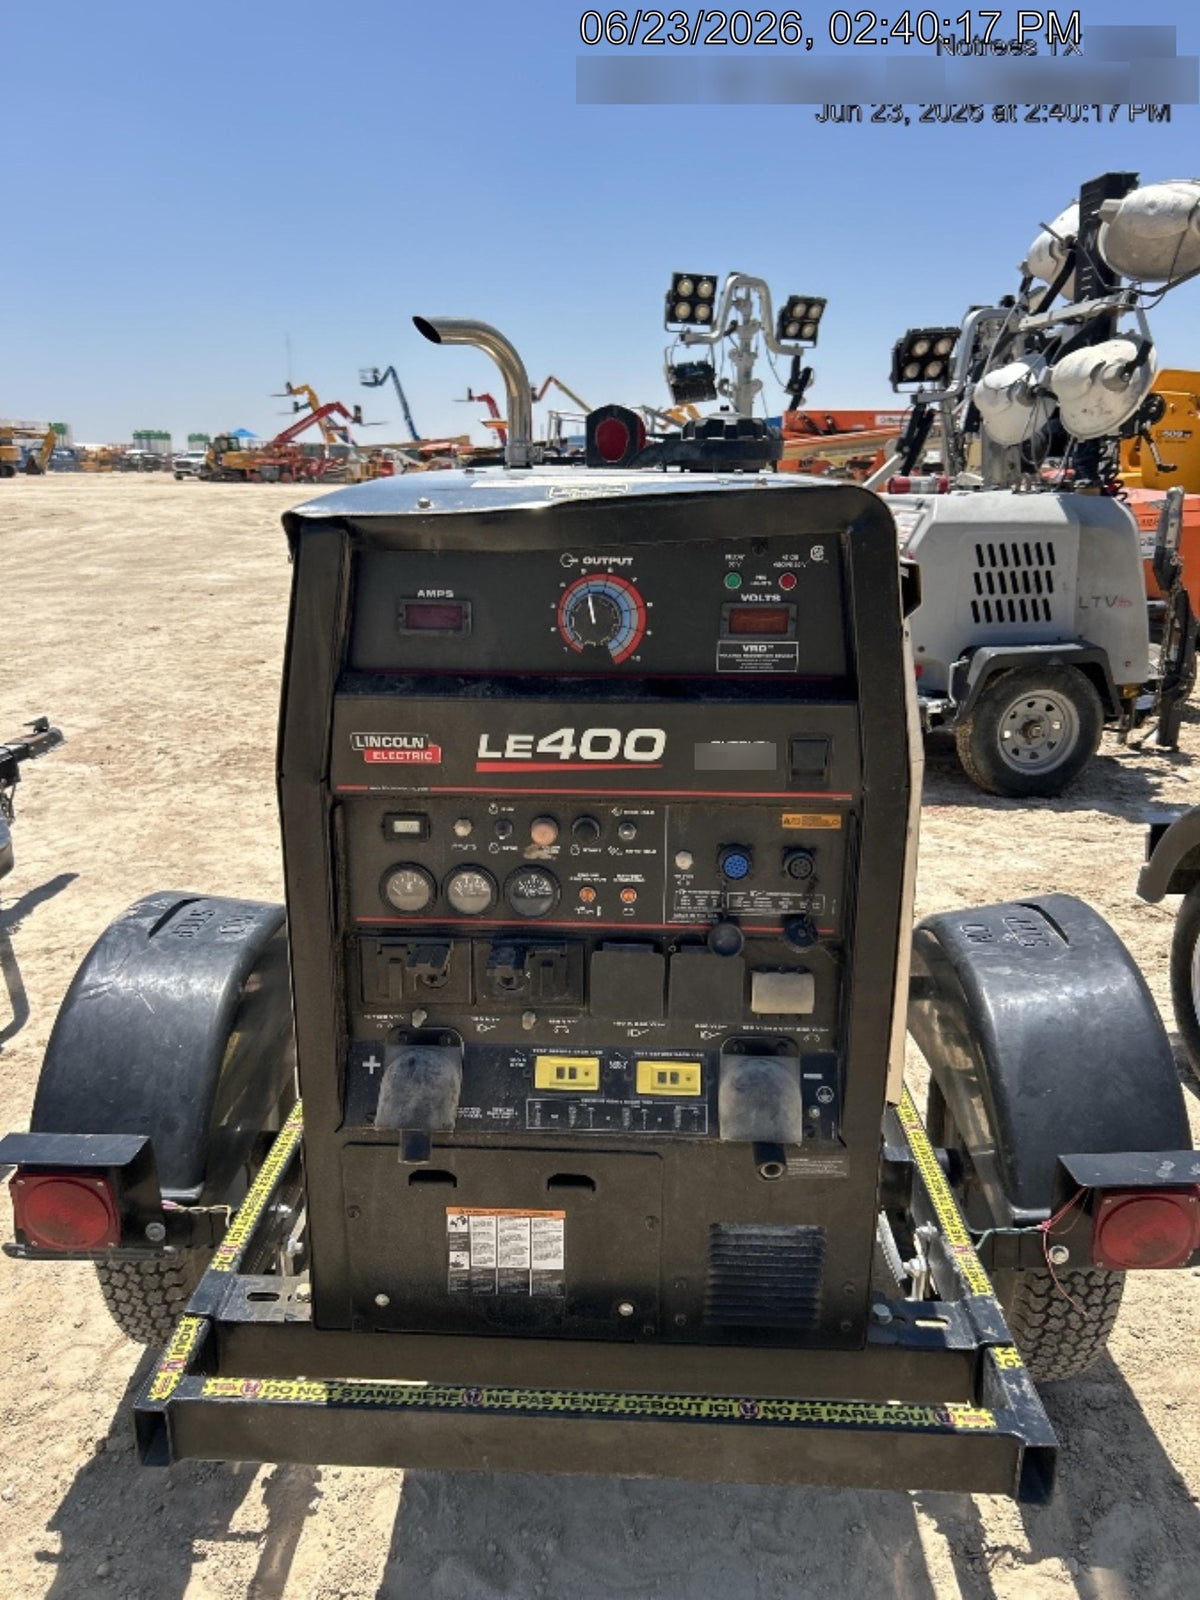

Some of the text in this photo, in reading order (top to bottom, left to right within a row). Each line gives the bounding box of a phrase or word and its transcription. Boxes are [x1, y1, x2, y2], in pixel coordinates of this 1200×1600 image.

[582, 556, 634, 566] OUTPUT
[417, 589, 454, 599] AMPS
[355, 735, 424, 749] LINCOLN
[477, 728, 667, 762] LE400
[372, 751, 433, 761] ELECTRIC
[265, 1383, 460, 1402] DO NOT STAND HERE
[487, 1393, 733, 1413] NE PAS TENEZ DEBOUT ICI
[762, 1405, 930, 1421] NO SE PARE AQUI
